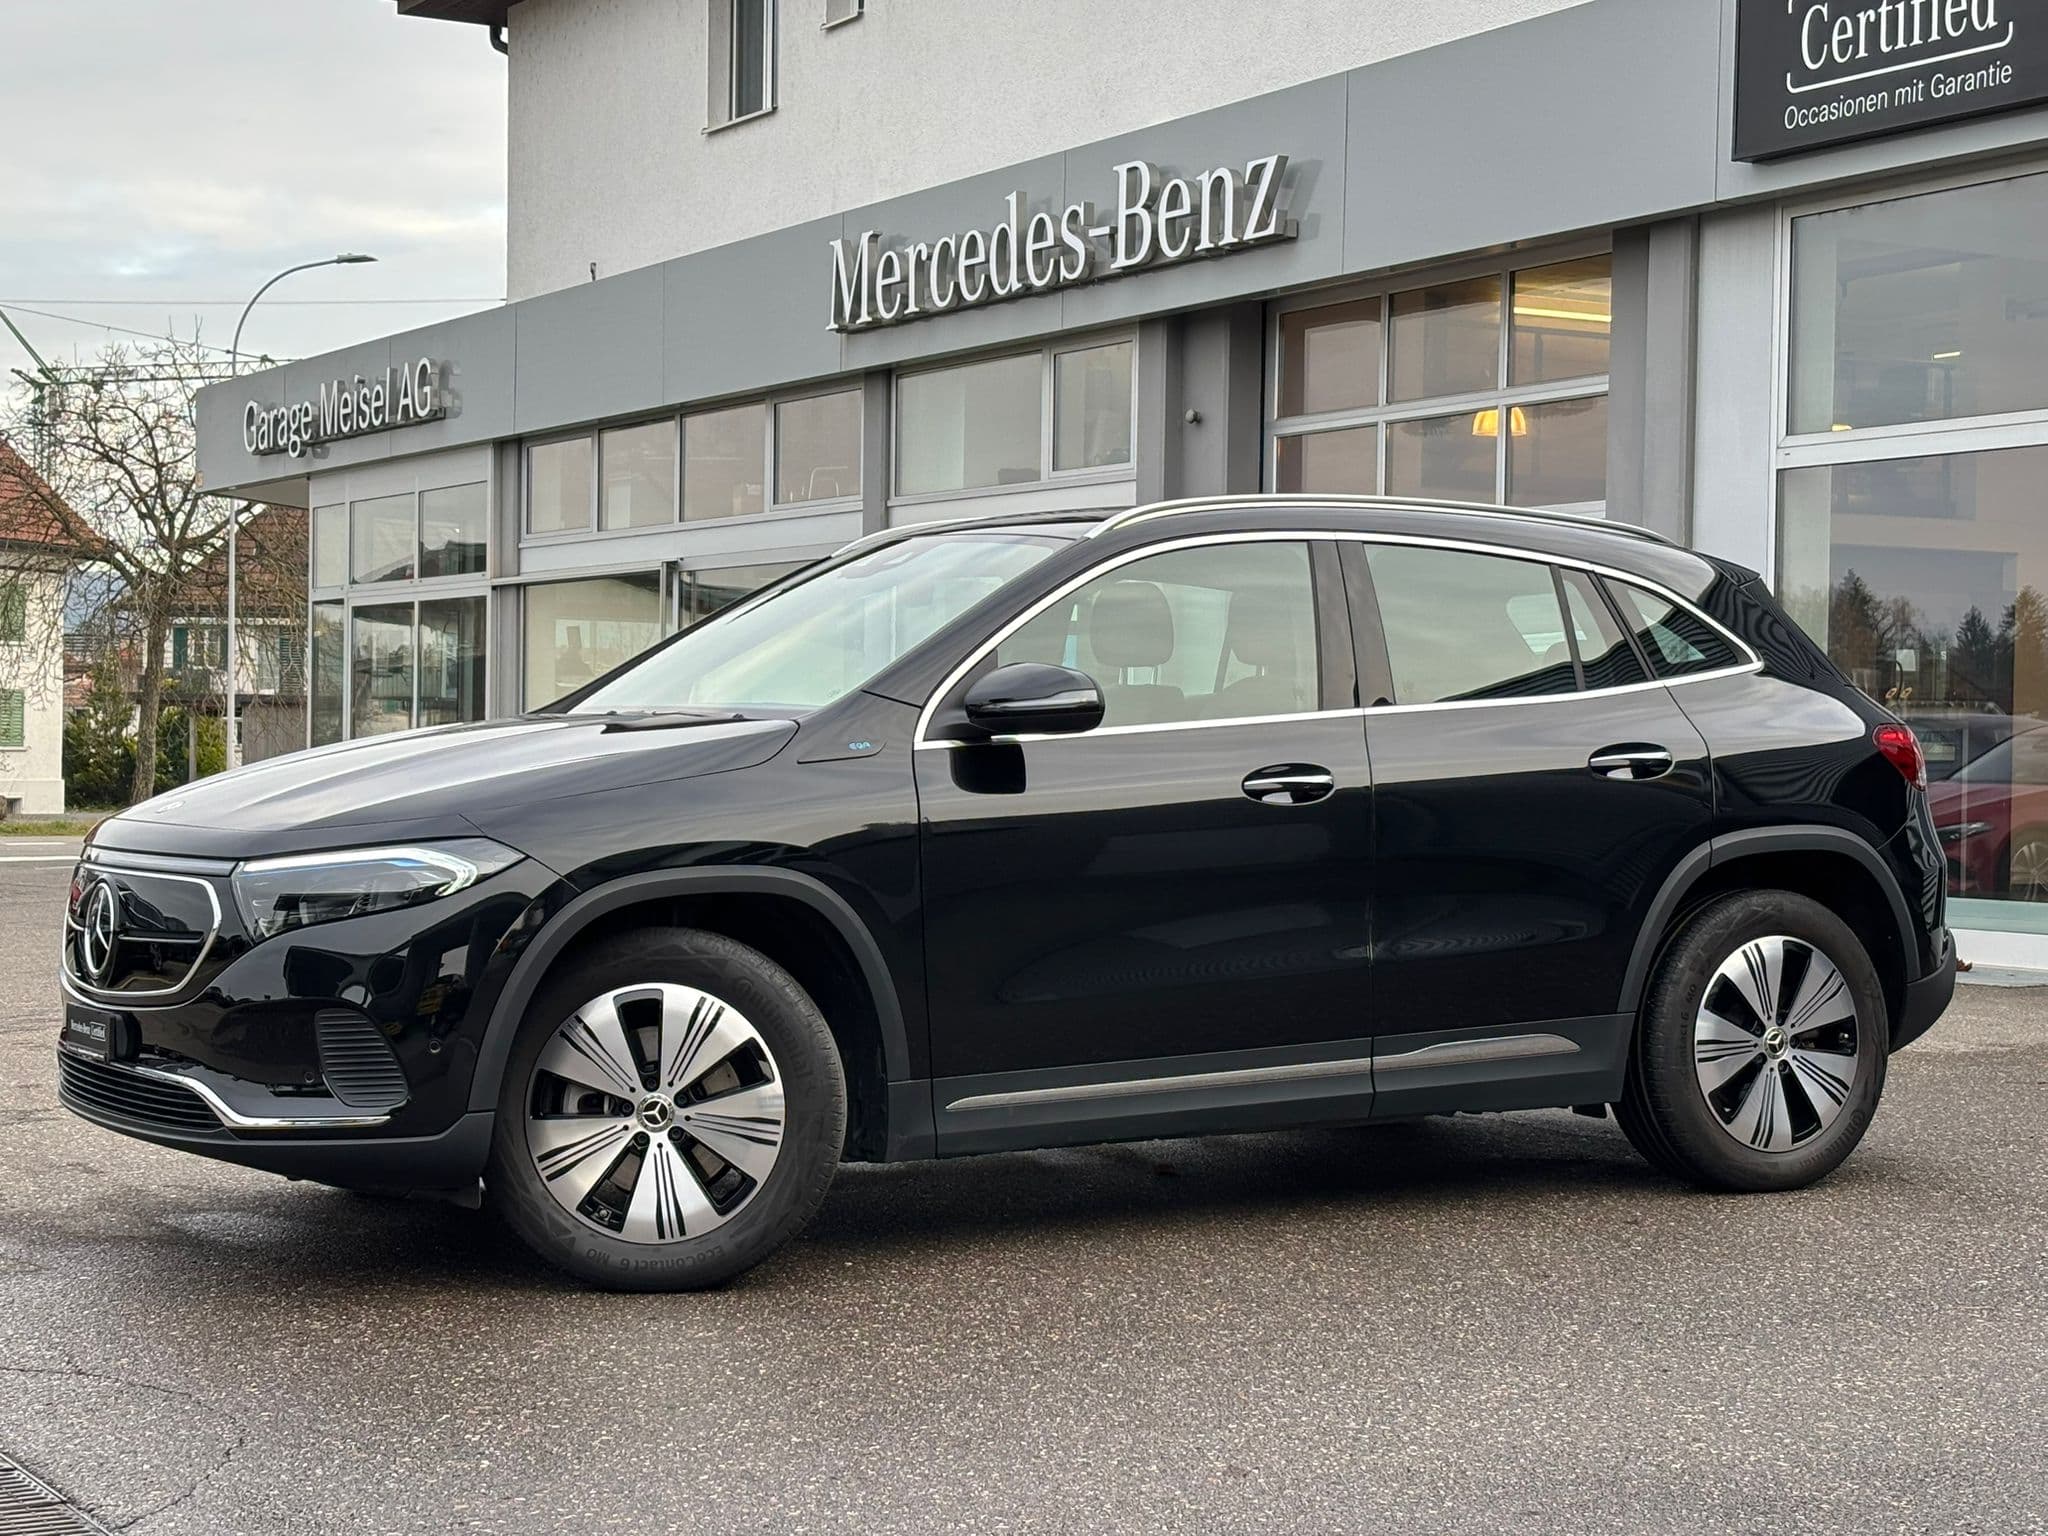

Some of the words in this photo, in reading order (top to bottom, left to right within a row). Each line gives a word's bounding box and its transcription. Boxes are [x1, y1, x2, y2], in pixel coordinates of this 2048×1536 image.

[1784, 91, 1888, 129] Occasionen
[1894, 79, 1925, 106] mit
[1930, 61, 2012, 98] Garantie
[826, 154, 1290, 332] Mercedes-Benz
[243, 400, 313, 458] Garage
[320, 366, 390, 437] Meisel
[397, 357, 433, 422] AG
